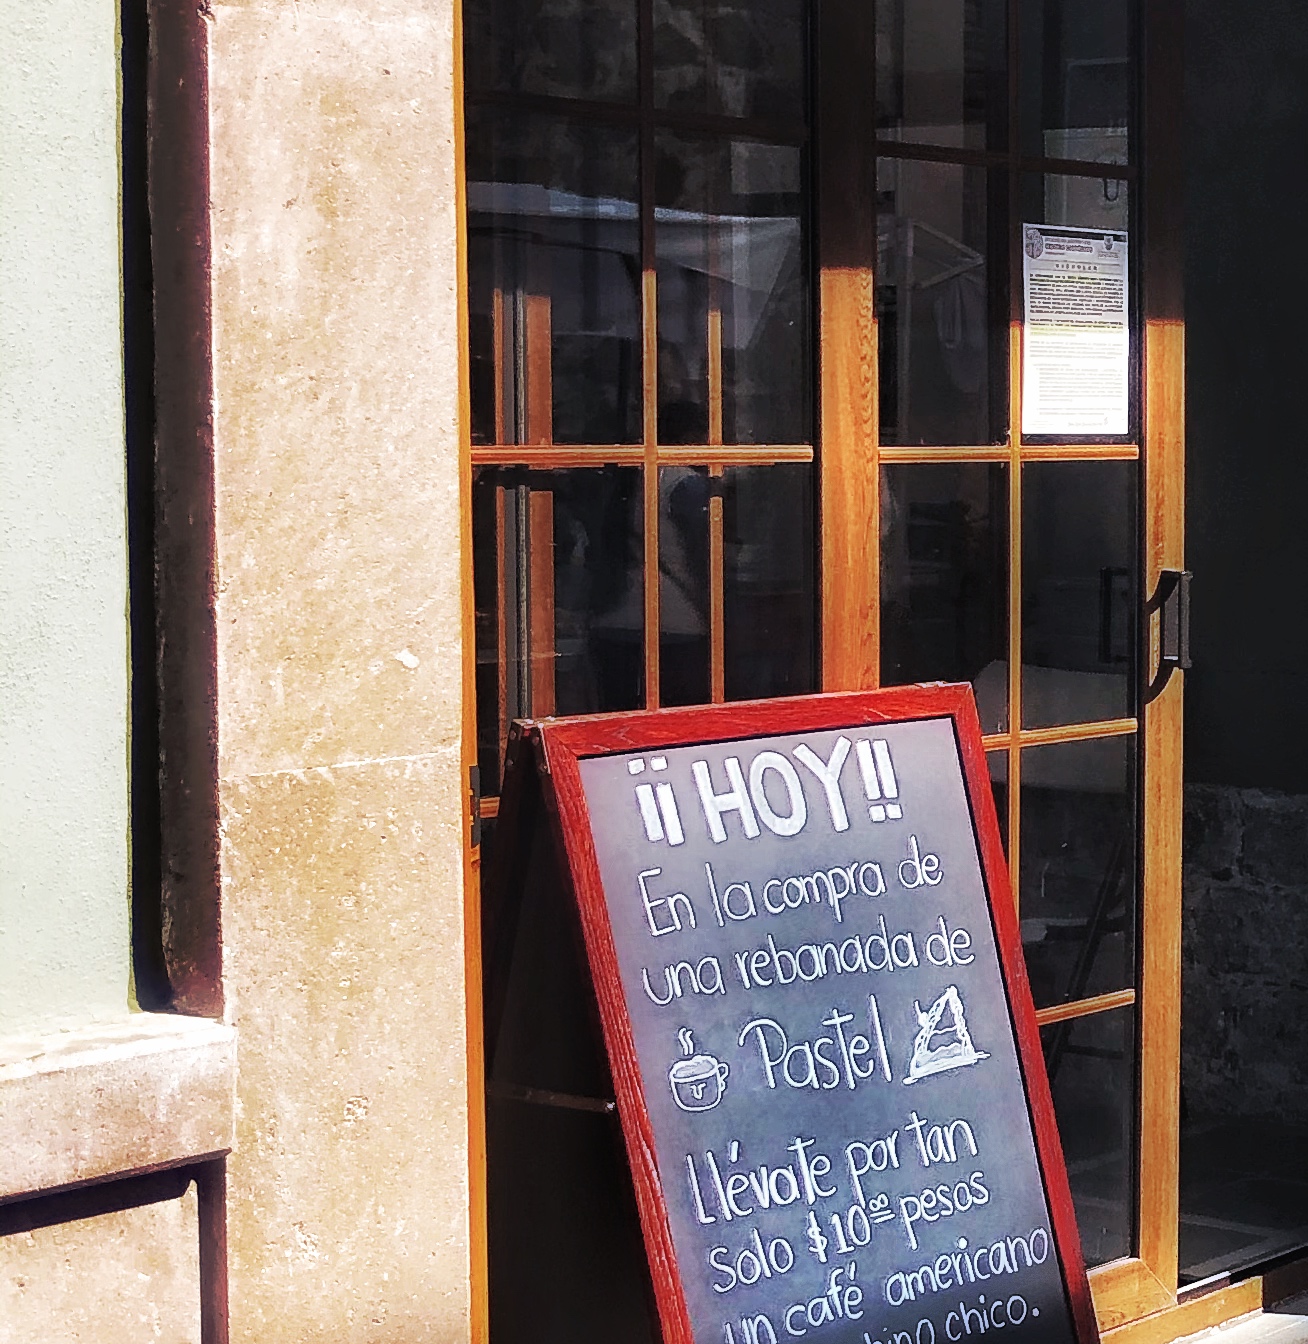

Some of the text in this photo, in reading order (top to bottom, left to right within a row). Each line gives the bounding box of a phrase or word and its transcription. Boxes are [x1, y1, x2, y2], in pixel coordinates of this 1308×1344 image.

[638, 834, 944, 937] En la compra de
[641, 915, 976, 1007] una rebanada de
[738, 994, 894, 1091] Pastel
[686, 1111, 980, 1226] Llévate por tan
[709, 1228, 794, 1294] Solo
[900, 1171, 991, 1251] pesos
[785, 1262, 864, 1338] café
[884, 1227, 1050, 1307] americano
[945, 1293, 1043, 1343] chico.
